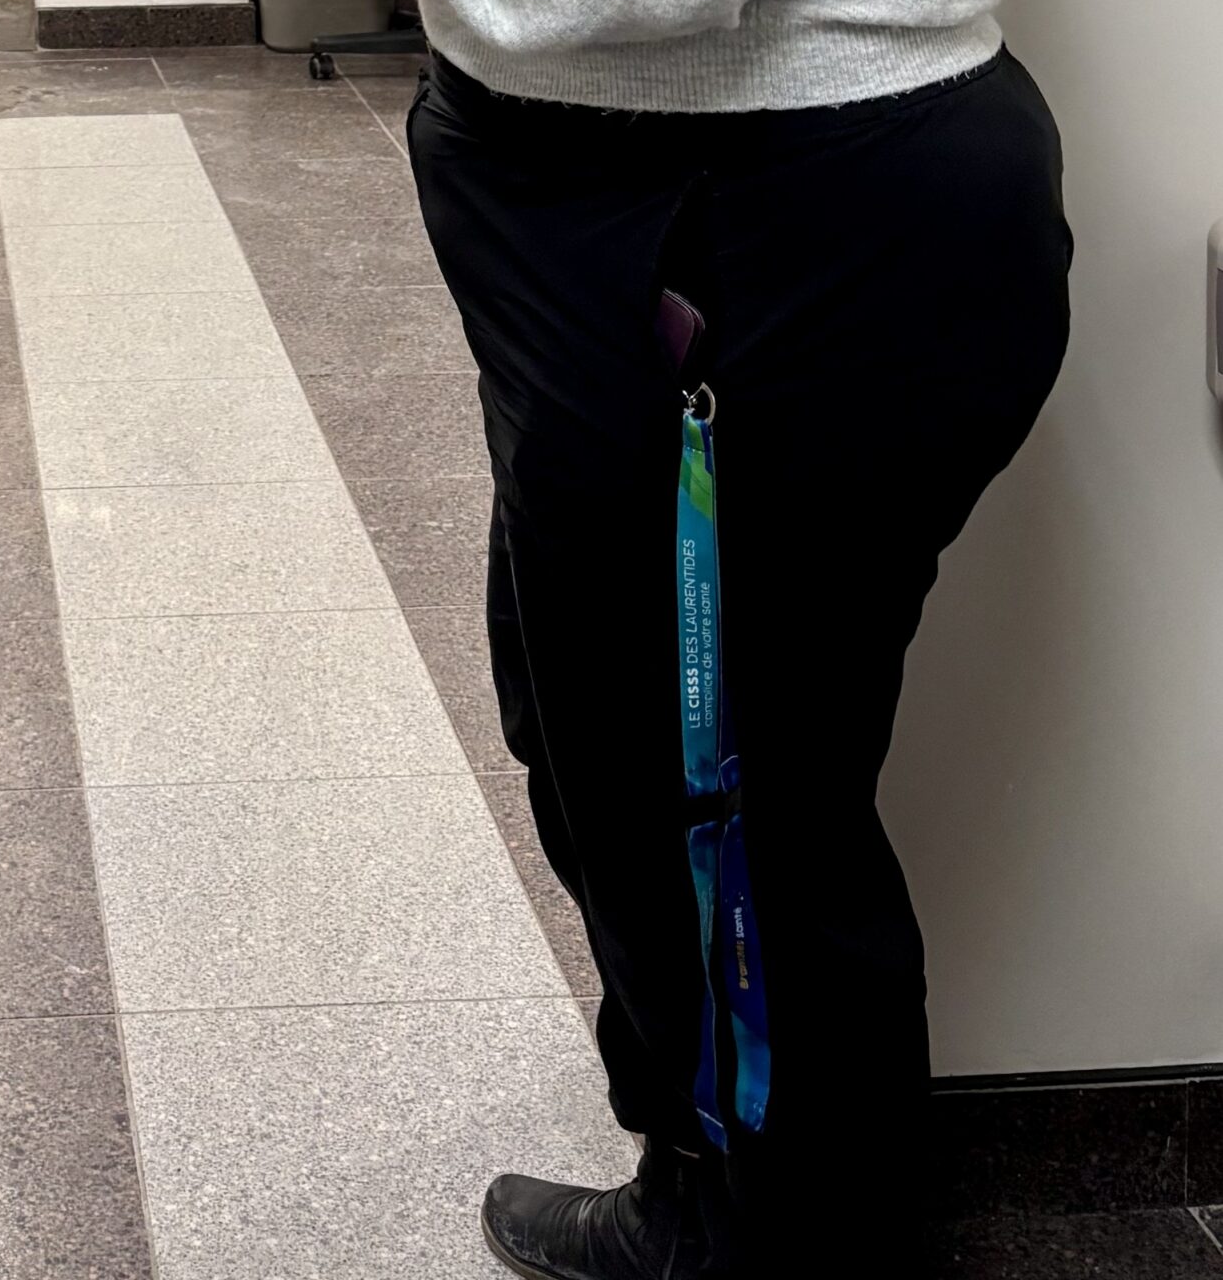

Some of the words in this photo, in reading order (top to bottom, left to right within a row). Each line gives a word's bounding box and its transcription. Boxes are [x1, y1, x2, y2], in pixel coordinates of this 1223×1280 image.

[682, 539, 697, 633] LAURENTIDES
[700, 581, 711, 615] santé
[685, 636, 698, 663] DES
[700, 617, 712, 649] votre
[702, 651, 713, 669] de
[686, 668, 700, 708] CISSS
[703, 671, 714, 727] complice
[688, 711, 701, 729] LE
